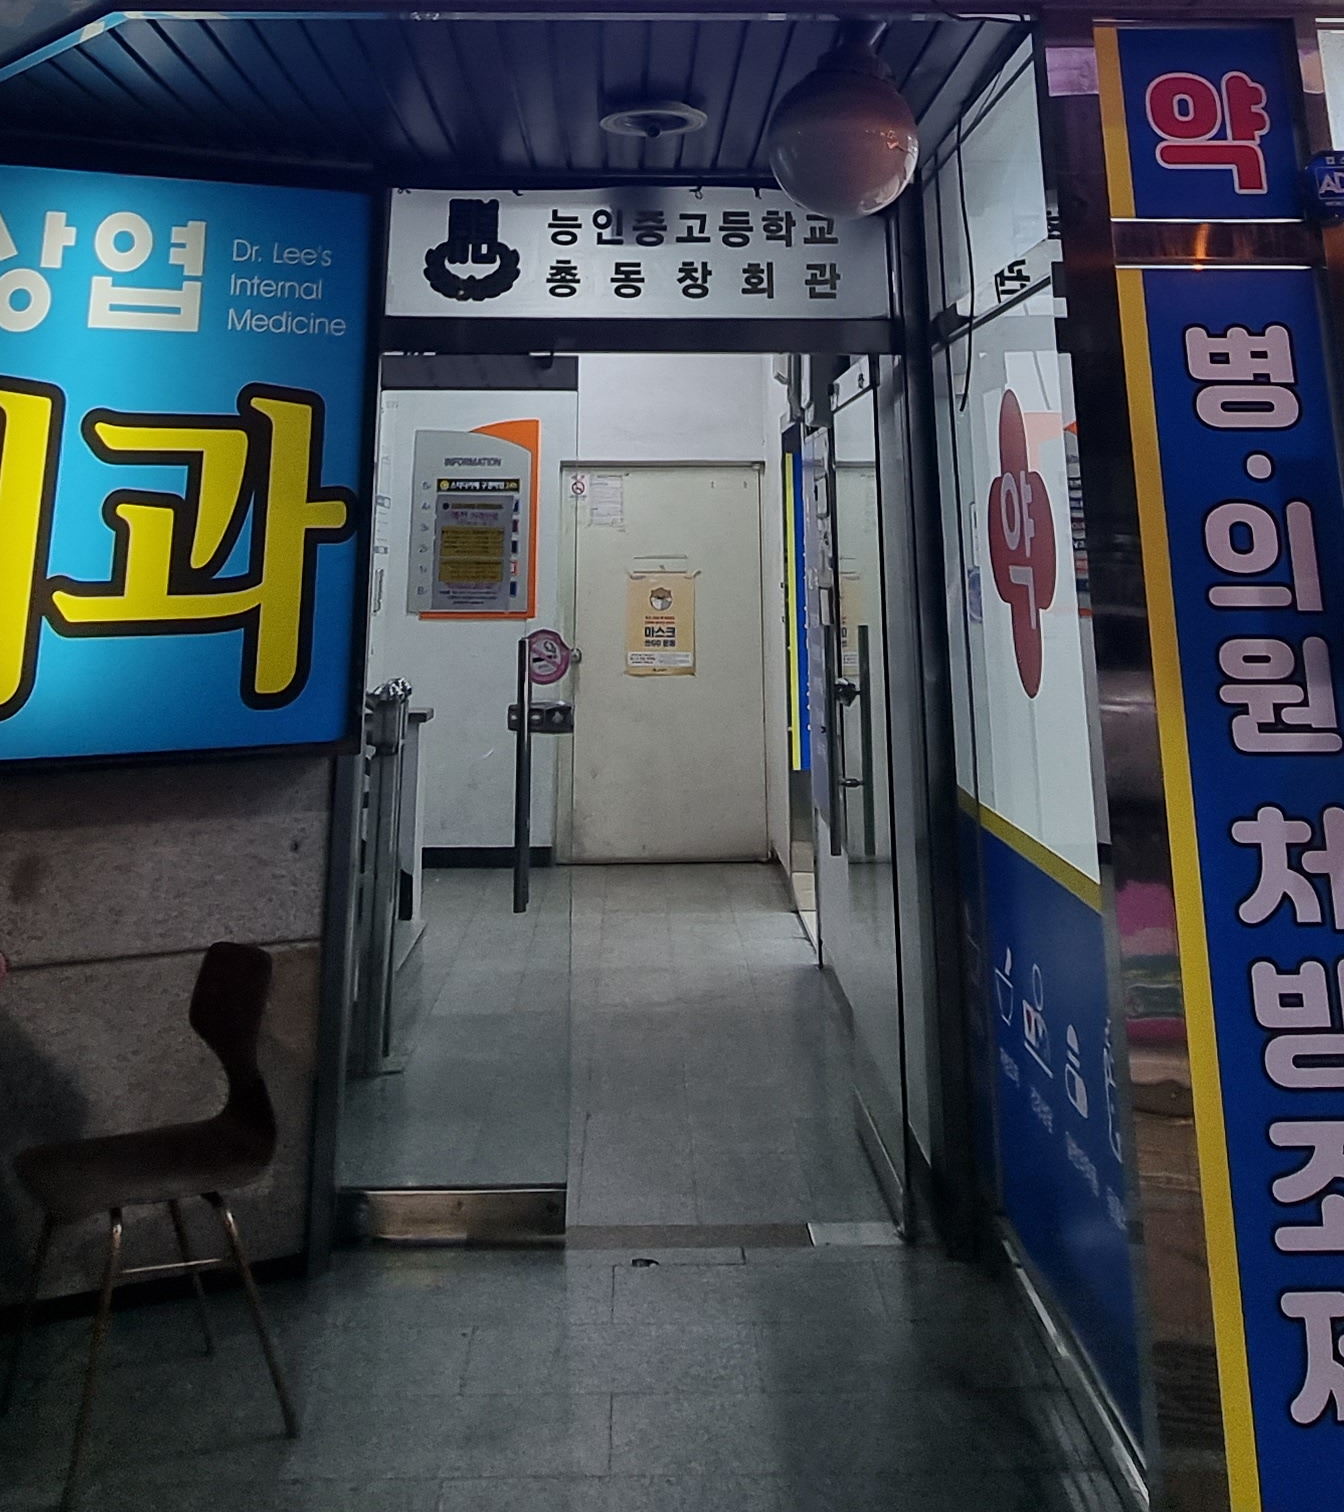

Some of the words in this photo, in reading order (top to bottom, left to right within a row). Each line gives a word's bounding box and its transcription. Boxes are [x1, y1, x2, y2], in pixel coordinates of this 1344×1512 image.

[1145, 69, 1271, 195] 약
[232, 238, 263, 263] Dr.
[273, 242, 333, 267] Lee's
[230, 273, 323, 300] Internal
[227, 307, 347, 337] Medicine
[1000, 470, 1037, 630] 약
